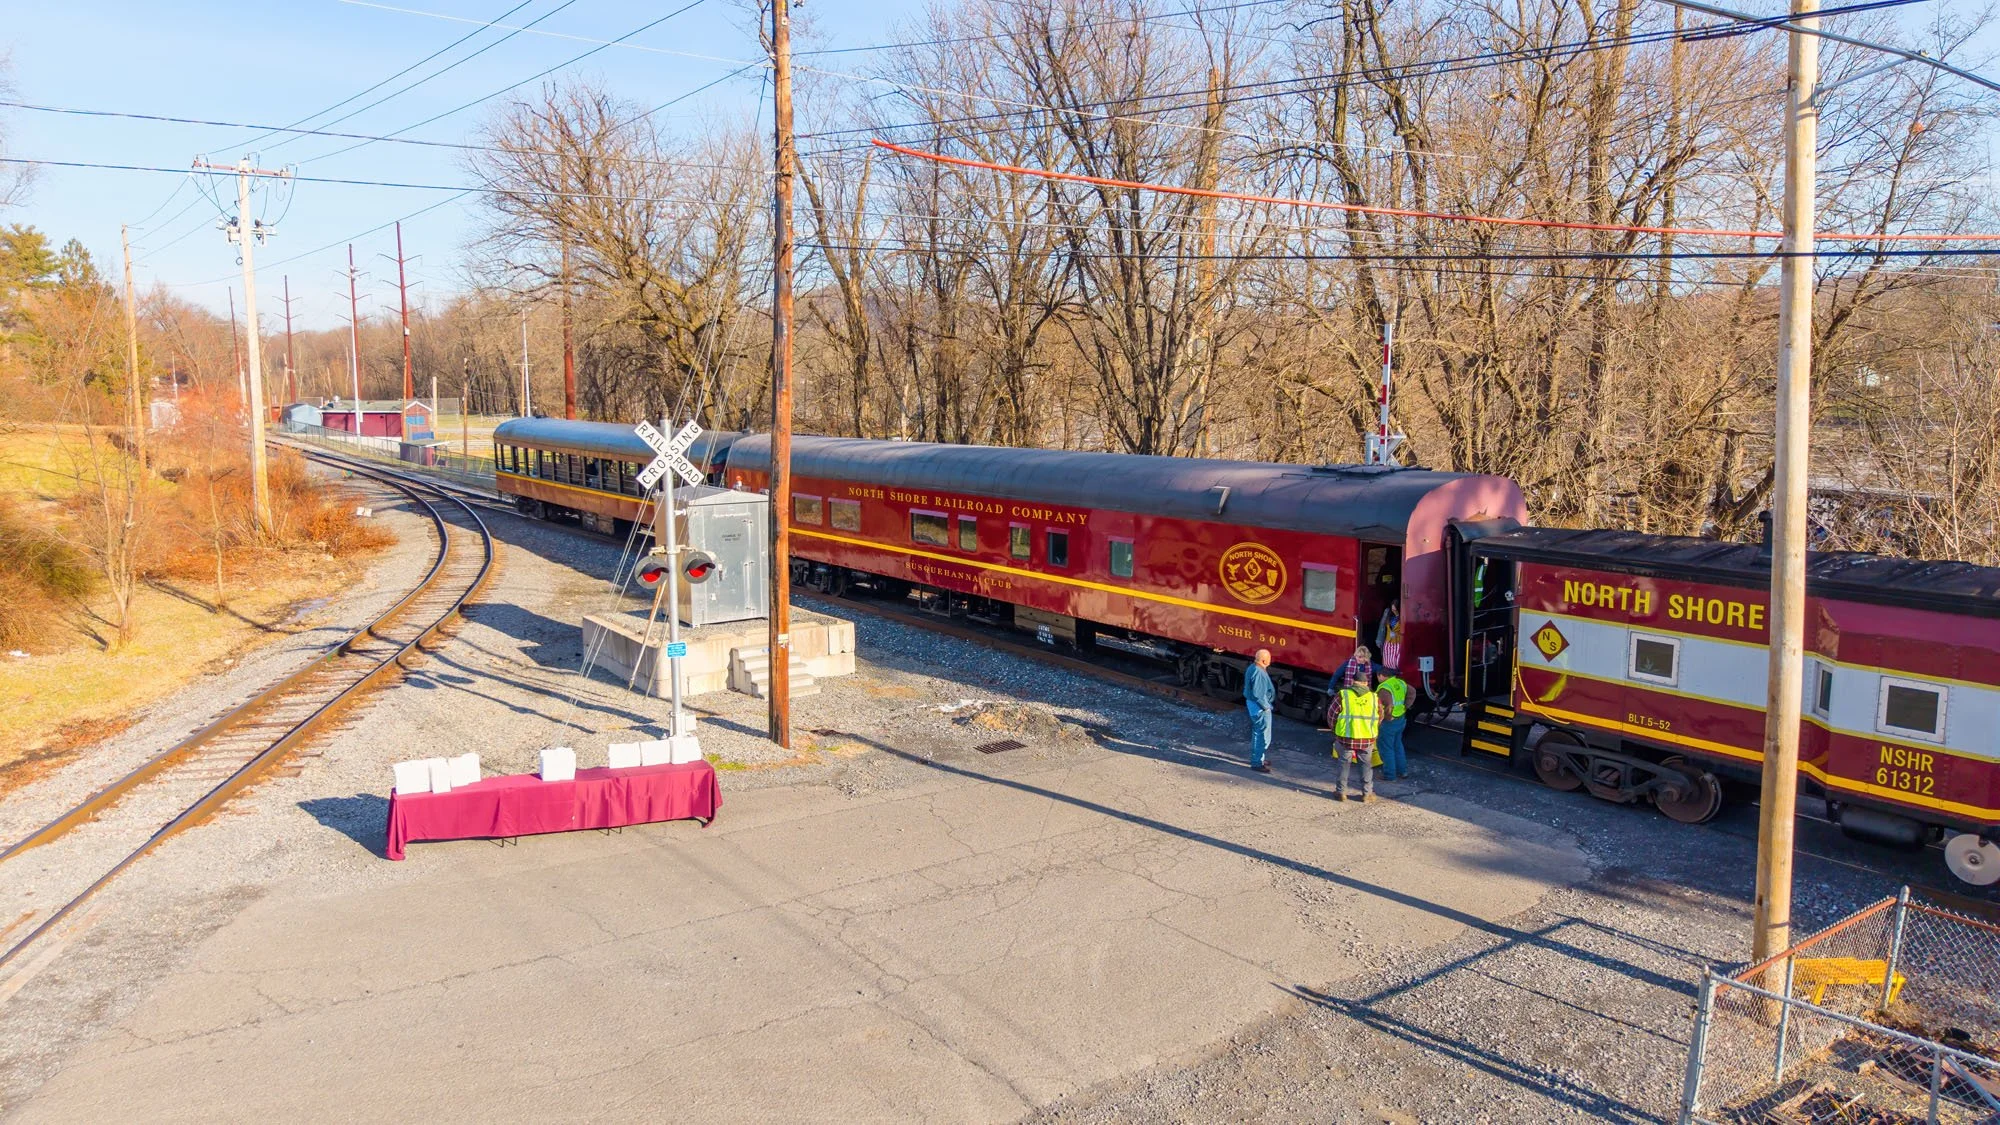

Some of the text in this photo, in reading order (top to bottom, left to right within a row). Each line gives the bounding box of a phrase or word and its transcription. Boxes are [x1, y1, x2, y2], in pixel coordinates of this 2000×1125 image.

[638, 424, 700, 483] RAIL ROAD
[641, 424, 699, 485] CROSSING
[848, 487, 1088, 525] NORTH SHORE RAILROAD COMPANY
[1229, 551, 1278, 568] NORTH SHORE
[905, 561, 1012, 590] SUSQUEHANNA CLUB
[1564, 580, 1765, 630] NORTH SHORE
[1218, 624, 1286, 647] NSHR 500
[1880, 745, 1934, 773] NSHR
[1876, 767, 1935, 795] 61312
